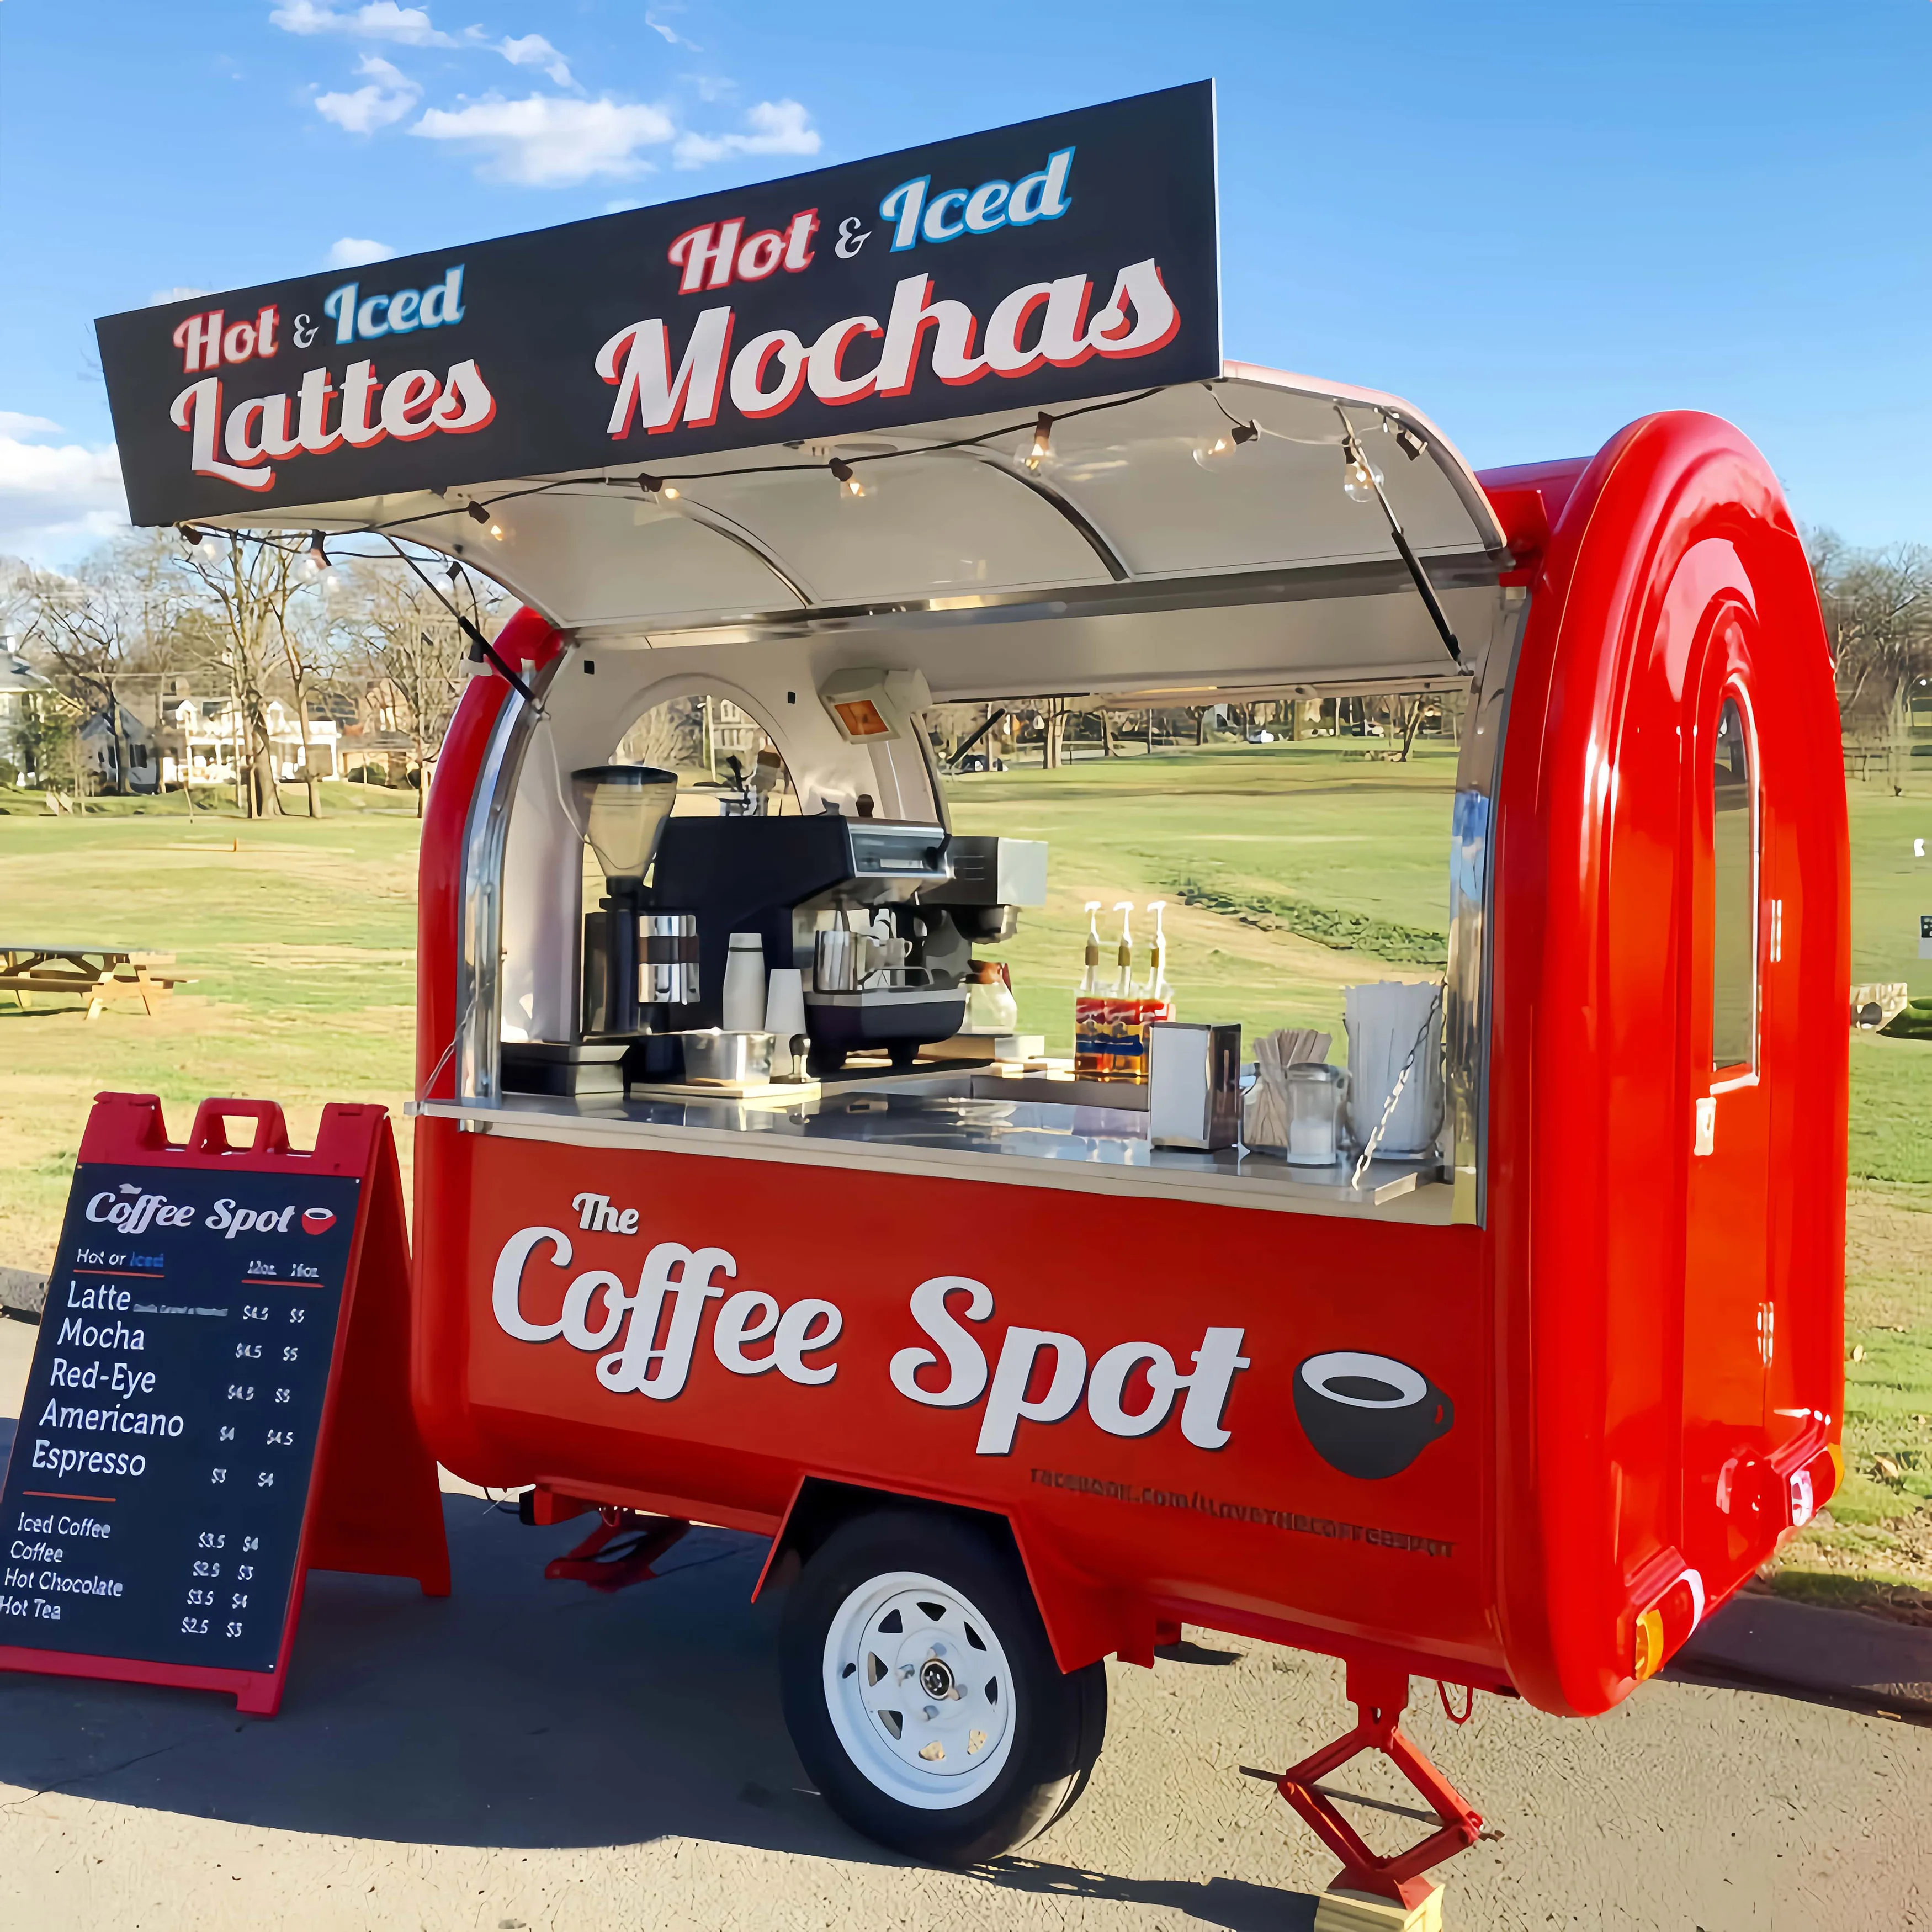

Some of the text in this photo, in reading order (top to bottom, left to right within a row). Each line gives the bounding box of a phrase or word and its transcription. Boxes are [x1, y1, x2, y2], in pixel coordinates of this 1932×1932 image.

[668, 145, 1076, 295] Hot & Iced
[173, 263, 465, 373] Hot & Iced
[594, 257, 1181, 440] Mochas
[169, 359, 497, 492] Lattes
[86, 1192, 295, 1239] Coffee Spot
[572, 1192, 639, 1234] The
[76, 1248, 104, 1265] Hot
[109, 1254, 126, 1265] or
[67, 1280, 131, 1311] Latte
[57, 1317, 144, 1350] Mocha
[492, 1226, 1251, 1456] Coffee Spot
[50, 1358, 156, 1399] Red-Eye
[39, 1398, 184, 1437] Americano
[32, 1439, 146, 1478] Espresso
[17, 1512, 54, 1534] Iced
[57, 1516, 111, 1538] Coffee
[10, 1540, 63, 1563] Coffee
[4, 1567, 34, 1588] Hot
[39, 1571, 123, 1597] Chocolate
[0, 1595, 28, 1617] Hot
[34, 1598, 61, 1620] Tea
